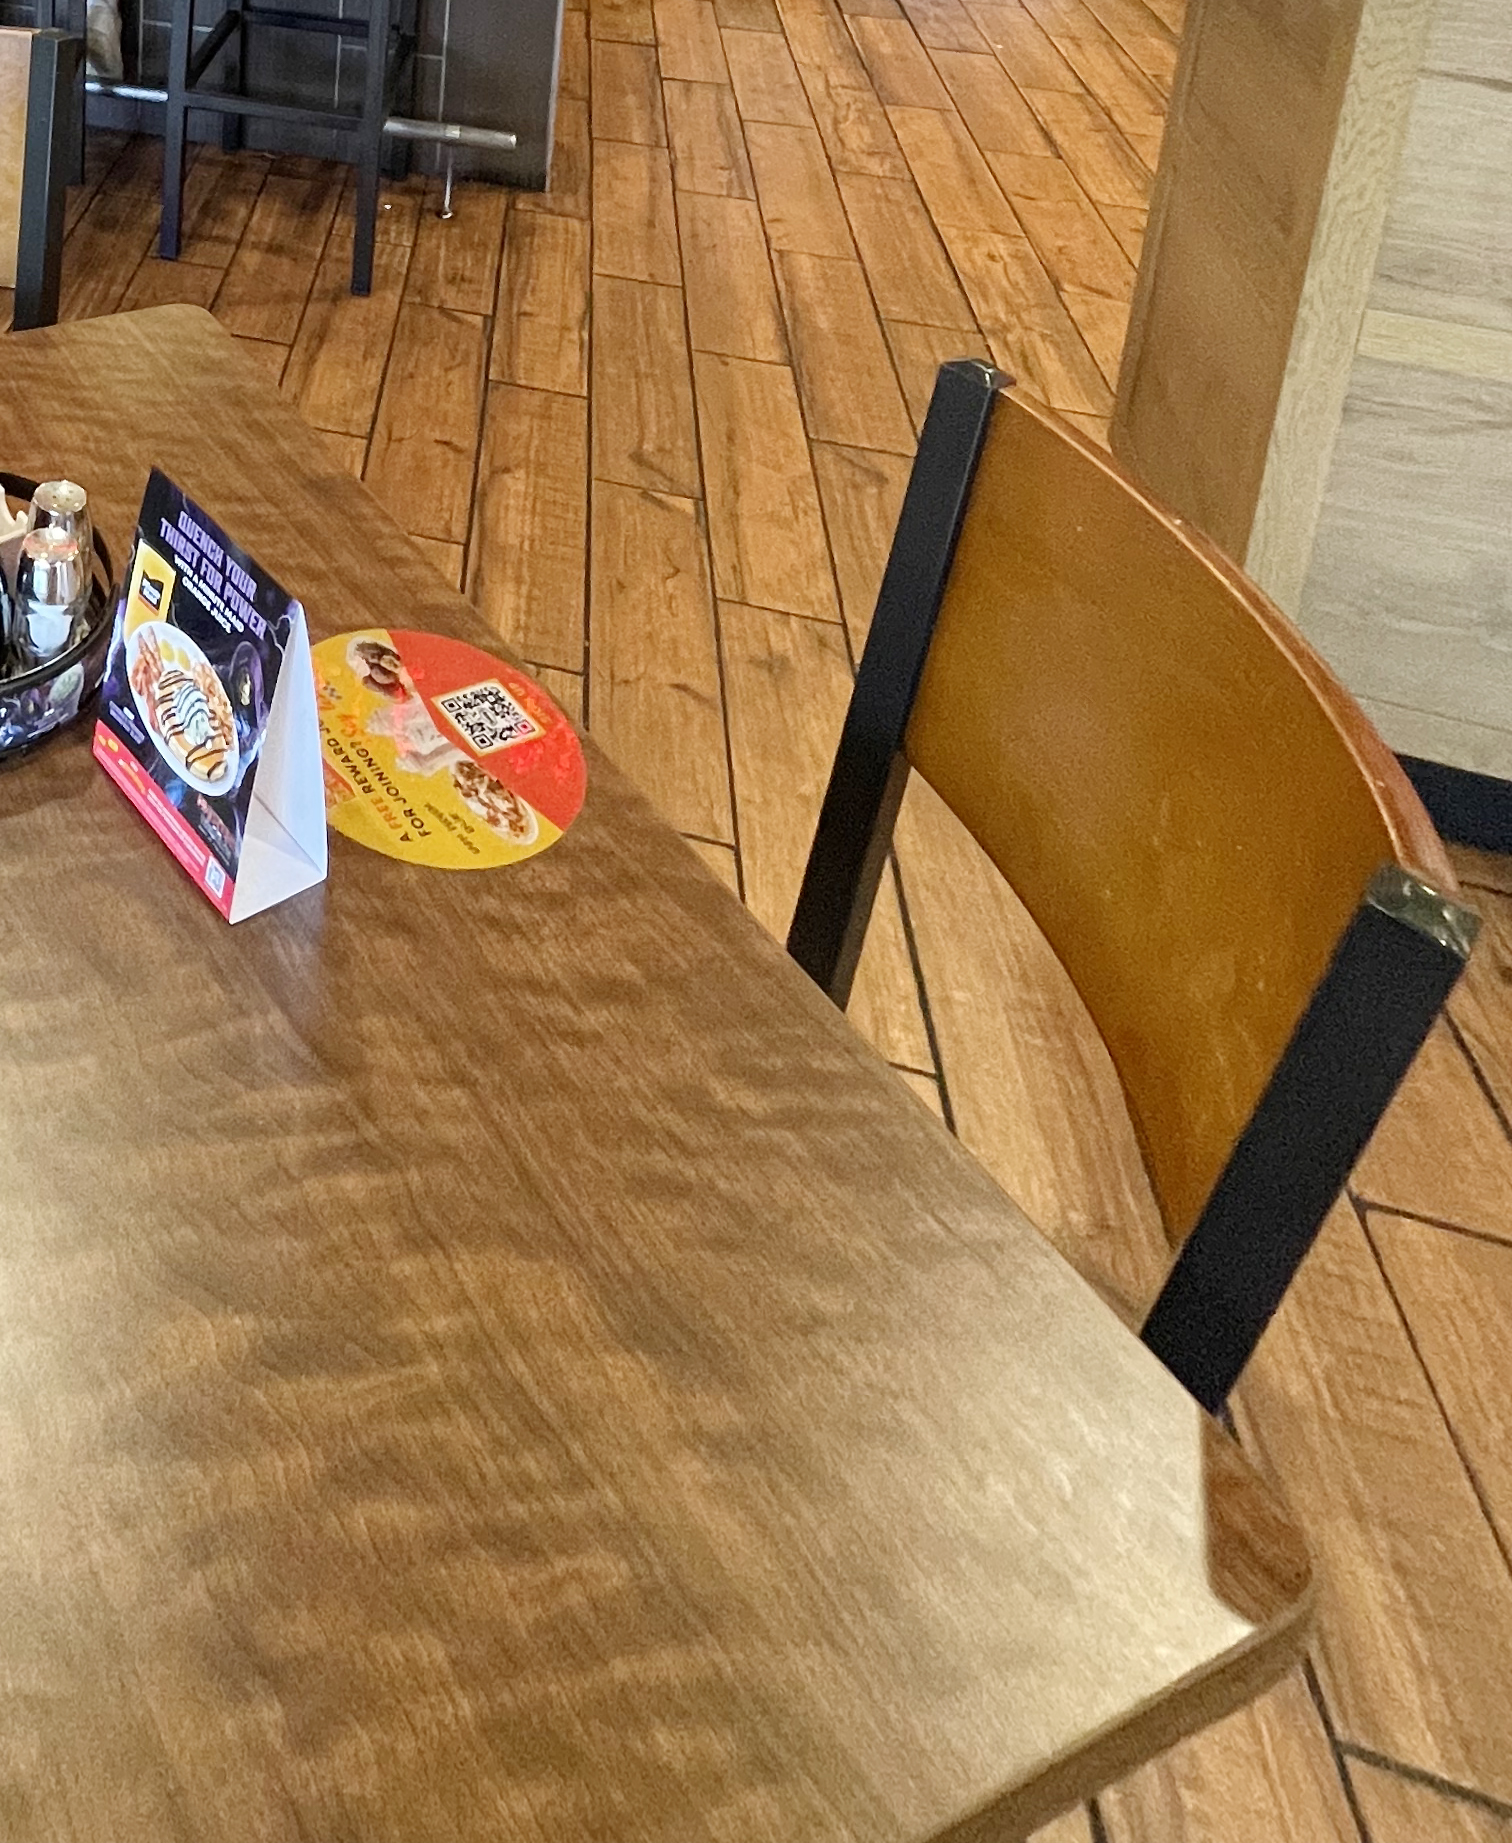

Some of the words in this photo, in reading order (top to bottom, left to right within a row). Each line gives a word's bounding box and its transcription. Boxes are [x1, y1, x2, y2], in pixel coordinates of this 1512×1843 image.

[160, 517, 200, 568] THIRST
[200, 557, 223, 595] FOR
[224, 582, 267, 640] POWER
[178, 510, 224, 568] QUENCH
[225, 555, 257, 602] YOUR
[327, 738, 375, 794] REWARD
[350, 741, 407, 804] JOINING?
[369, 796, 403, 830] FREE
[400, 831, 413, 842] A
[404, 809, 432, 837] FOR
